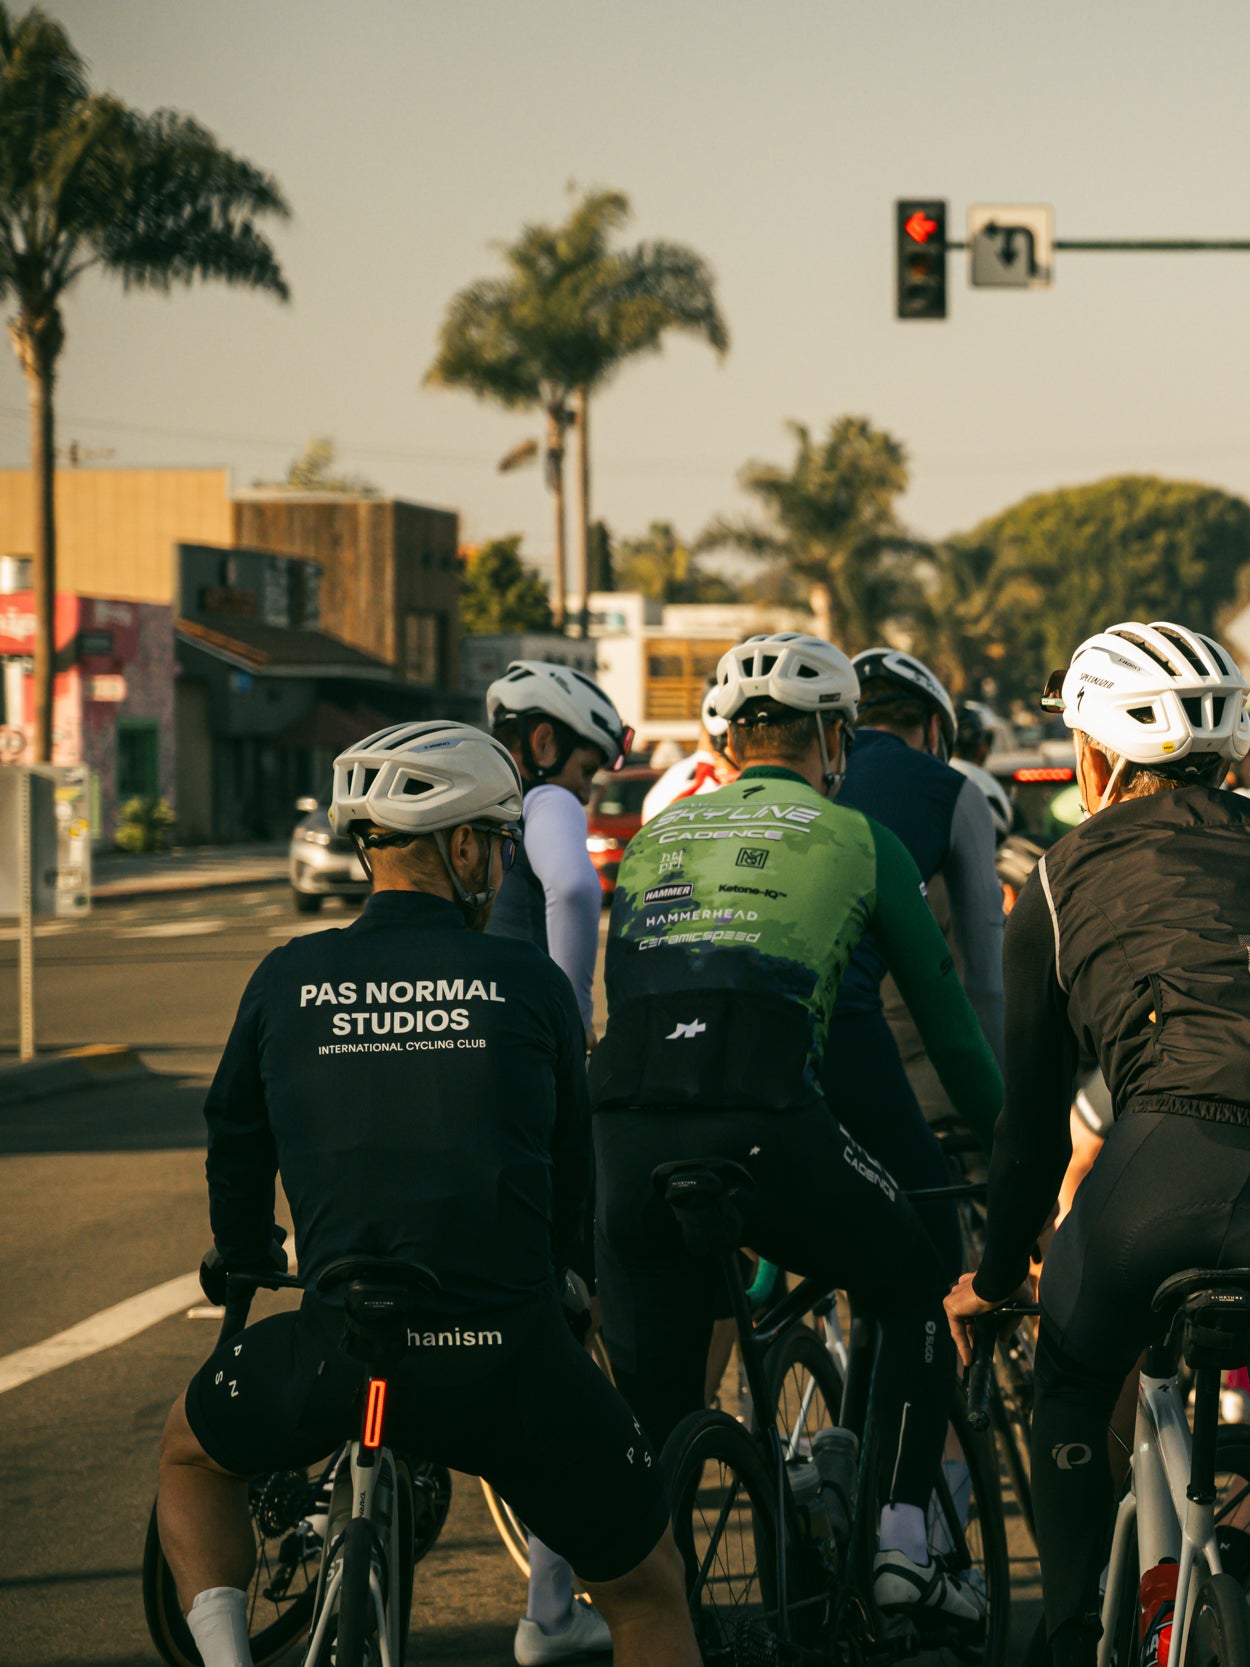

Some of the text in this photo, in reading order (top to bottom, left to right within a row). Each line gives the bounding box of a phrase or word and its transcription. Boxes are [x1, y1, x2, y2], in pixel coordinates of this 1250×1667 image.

[658, 829, 784, 845] CADENCE
[645, 886, 691, 900] HAMMER
[646, 908, 758, 927] HAMMERHEAD
[300, 979, 506, 1008] PAS NORMAL
[332, 1008, 470, 1036] STUDIOS
[318, 1039, 487, 1055] INTERNATIONAL CYCLING CLUB
